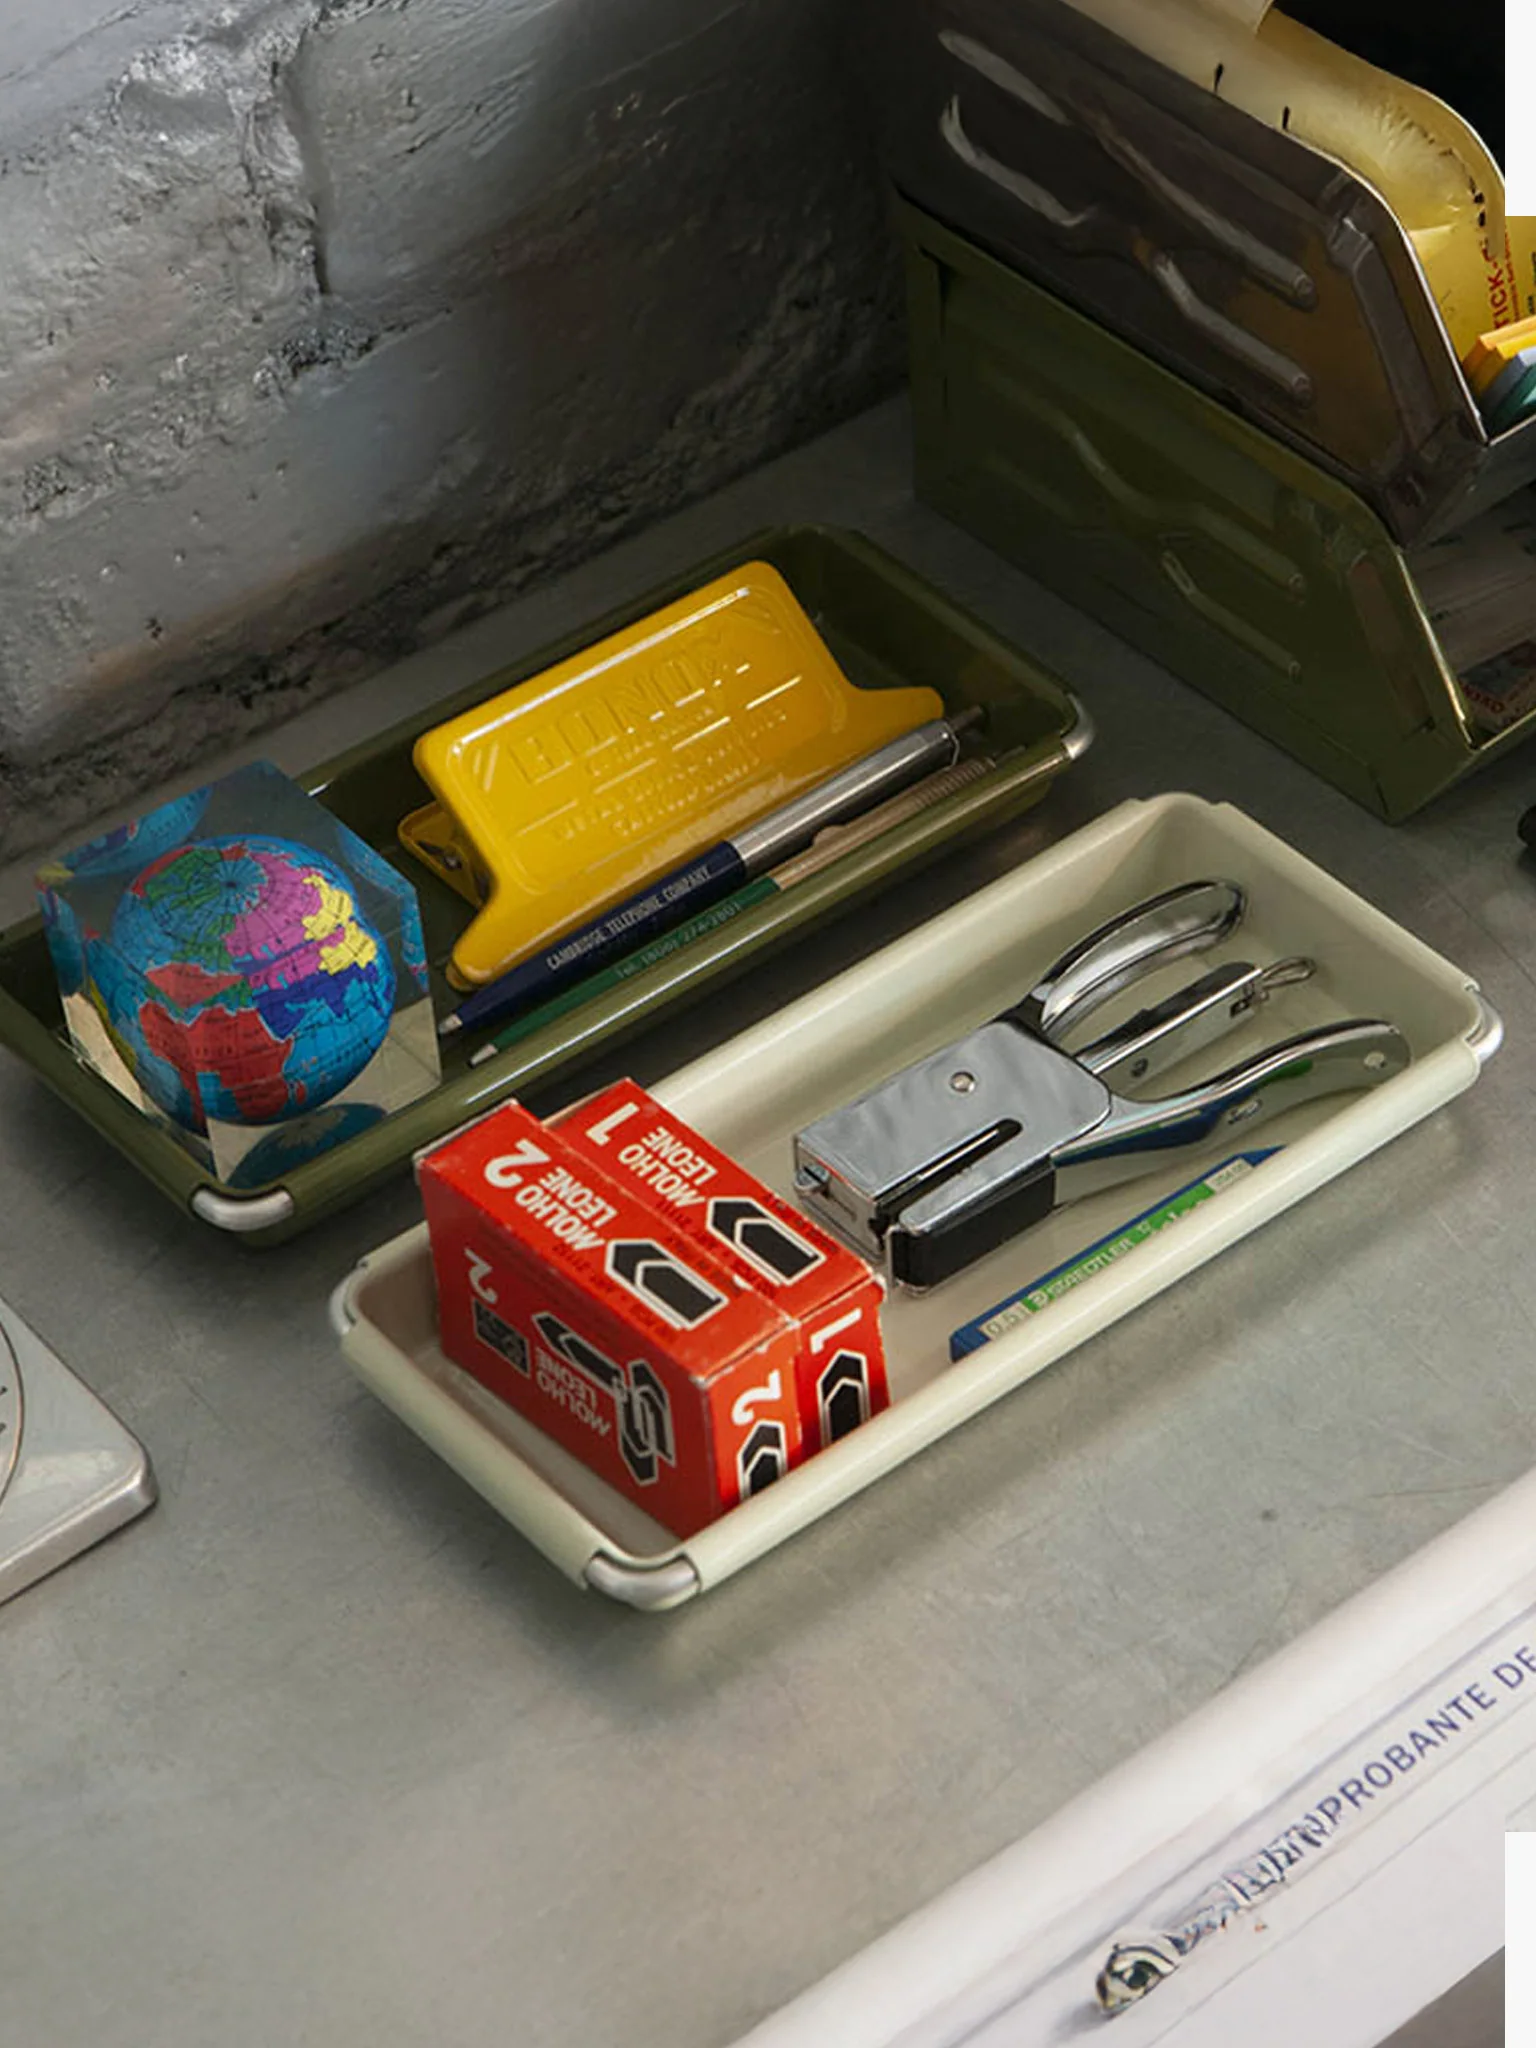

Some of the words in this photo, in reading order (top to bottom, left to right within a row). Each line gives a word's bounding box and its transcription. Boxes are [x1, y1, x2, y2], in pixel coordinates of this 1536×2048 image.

[546, 926, 607, 971] CAMBRIDGE
[605, 894, 663, 938] TELEPHONE
[662, 864, 712, 902] COMPANY
[586, 1102, 640, 1146] 1
[484, 1138, 551, 1188] 2
[617, 1143, 706, 1208] MOLHO
[640, 1126, 717, 1186] LEONE
[514, 1184, 605, 1251] MOLHO
[539, 1166, 618, 1228] LEONE
[464, 1247, 498, 1304] 2
[810, 1307, 862, 1355] 1
[536, 1347, 596, 1411] LEONE
[536, 1368, 611, 1436] MOLHO
[732, 1369, 782, 1426] 2
[1491, 1645, 1536, 1690] DE
